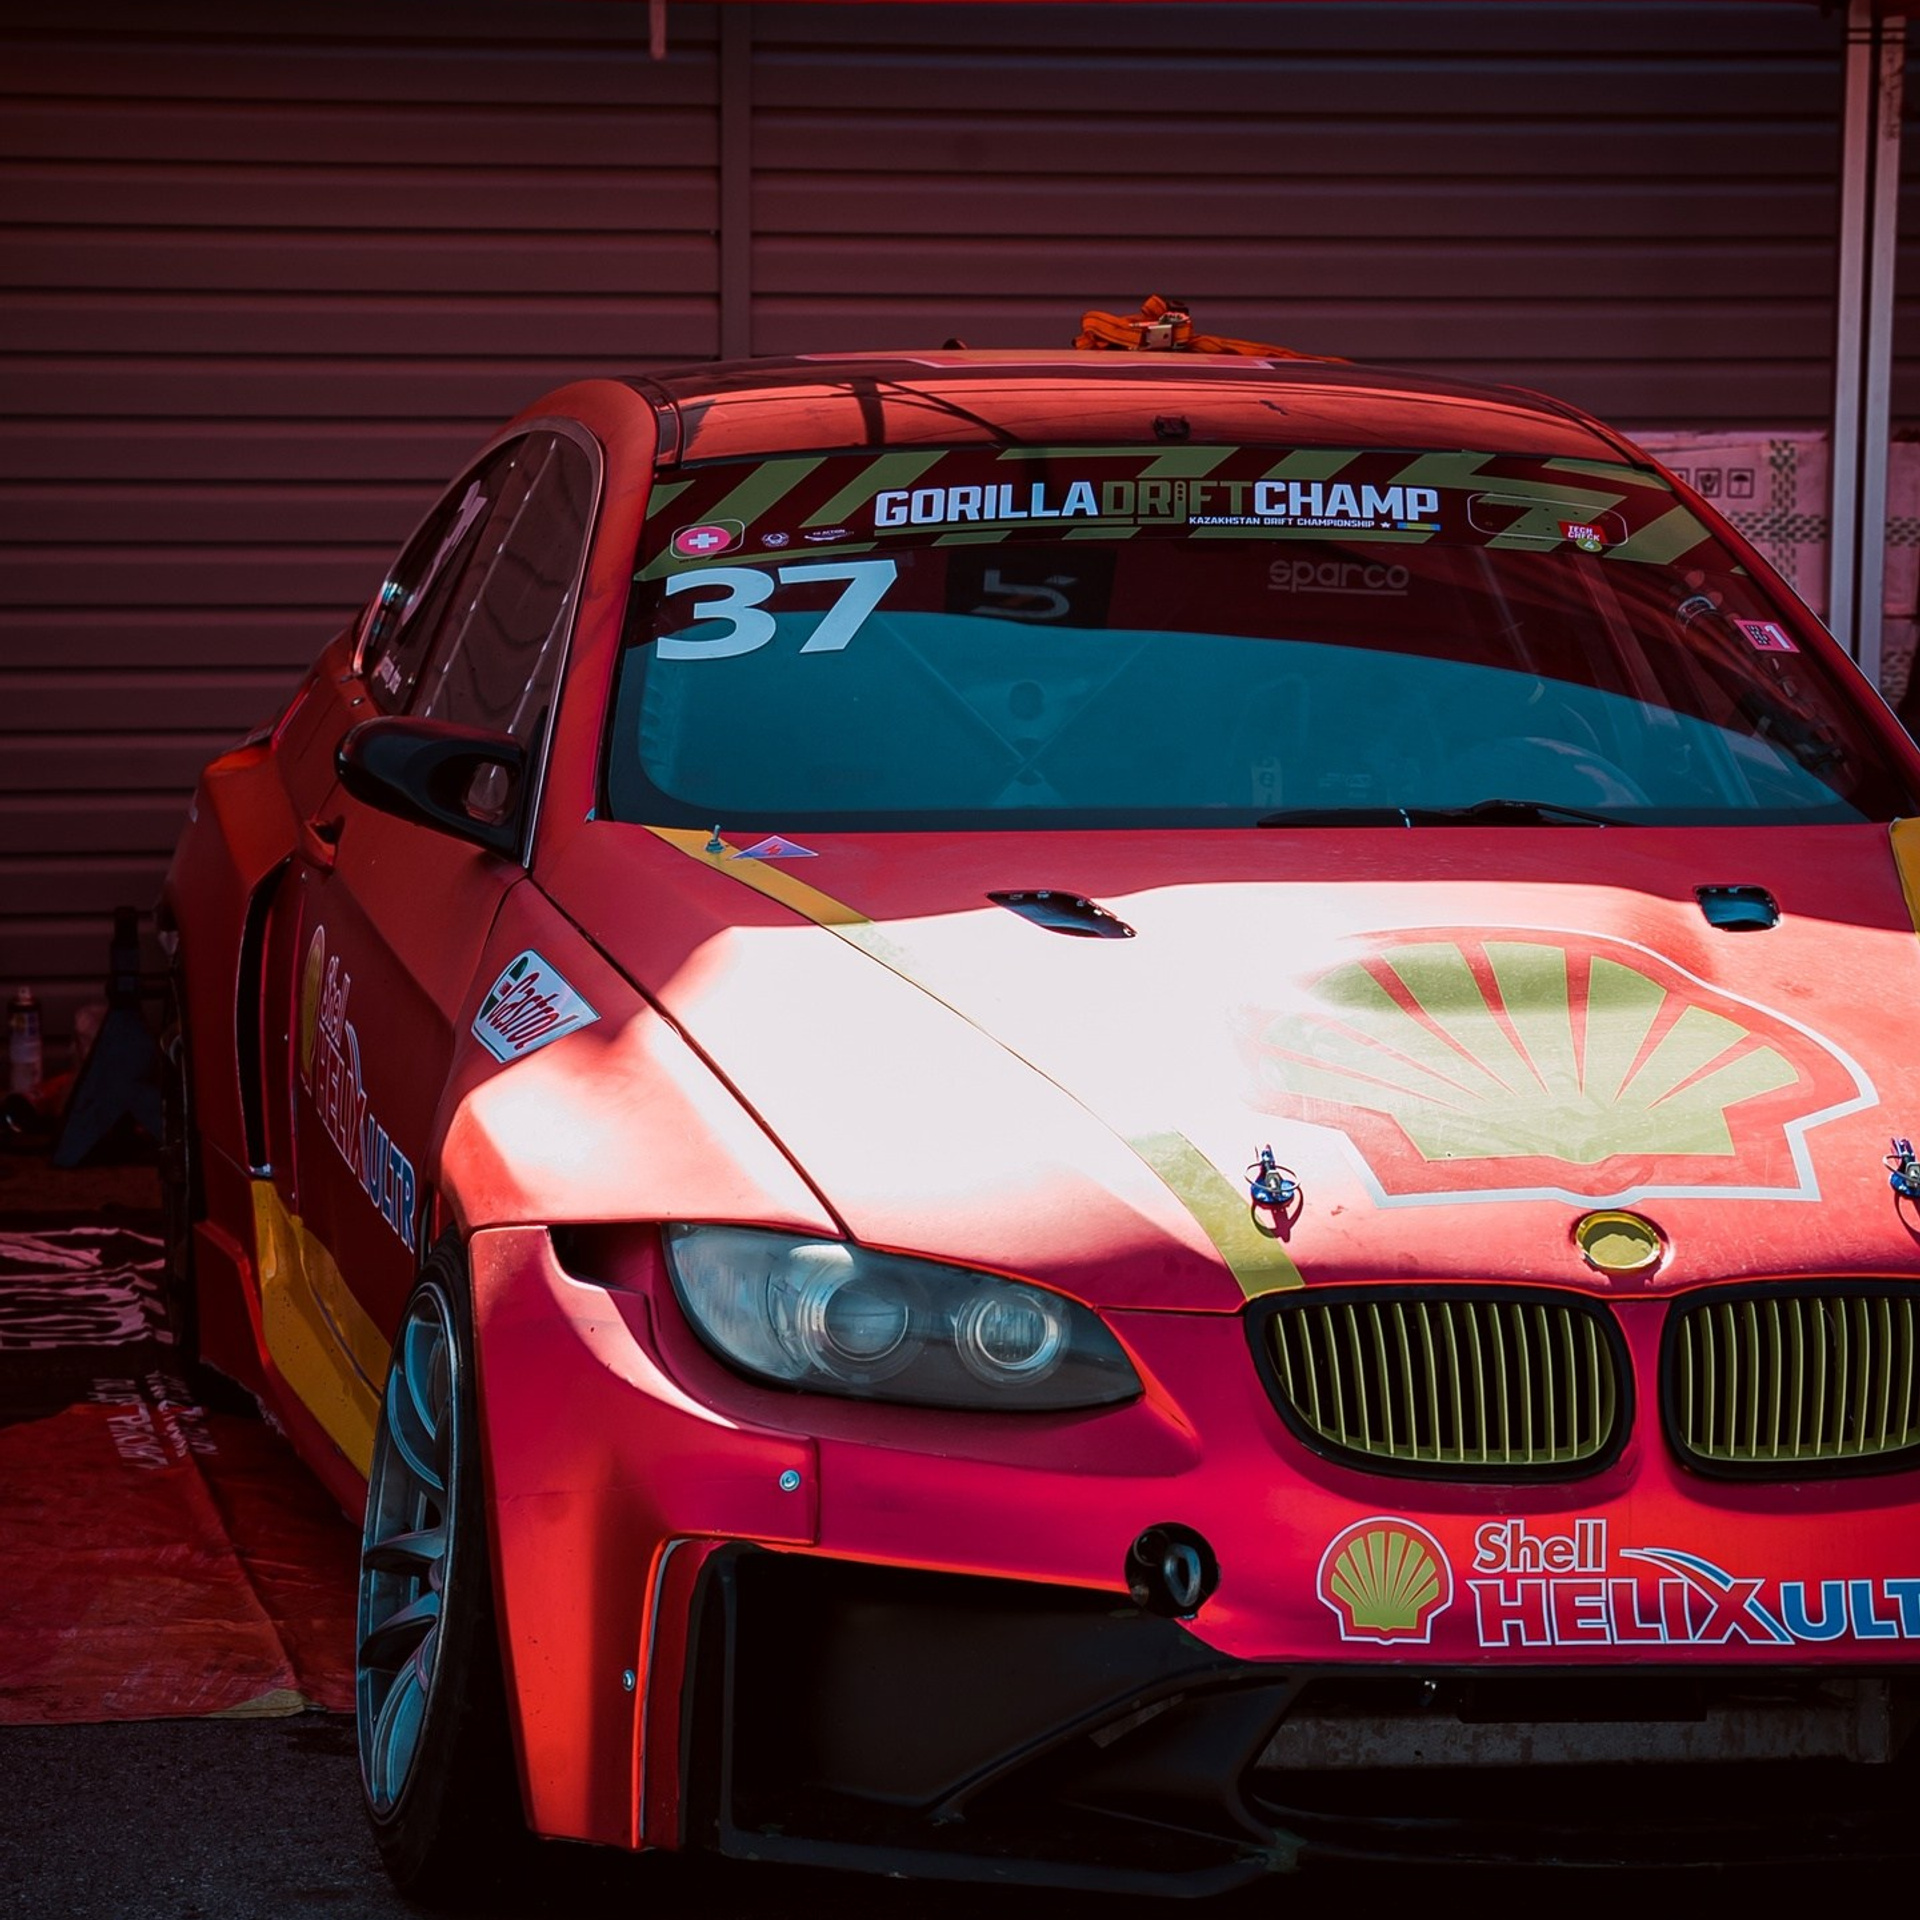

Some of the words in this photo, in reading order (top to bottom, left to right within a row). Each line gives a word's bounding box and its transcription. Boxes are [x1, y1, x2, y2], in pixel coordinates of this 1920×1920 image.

[1189, 516, 1260, 526] KAZAKHSTAN
[1263, 517, 1293, 526] DRIFT
[1297, 517, 1375, 529] CHAMPIONSHIP
[1567, 531, 1600, 542] CHECK
[1568, 525, 1594, 535] TECH
[1269, 559, 1410, 593] sparco
[656, 559, 898, 660] 37
[486, 971, 579, 1051] Castrol
[1473, 1517, 1608, 1574] Shell
